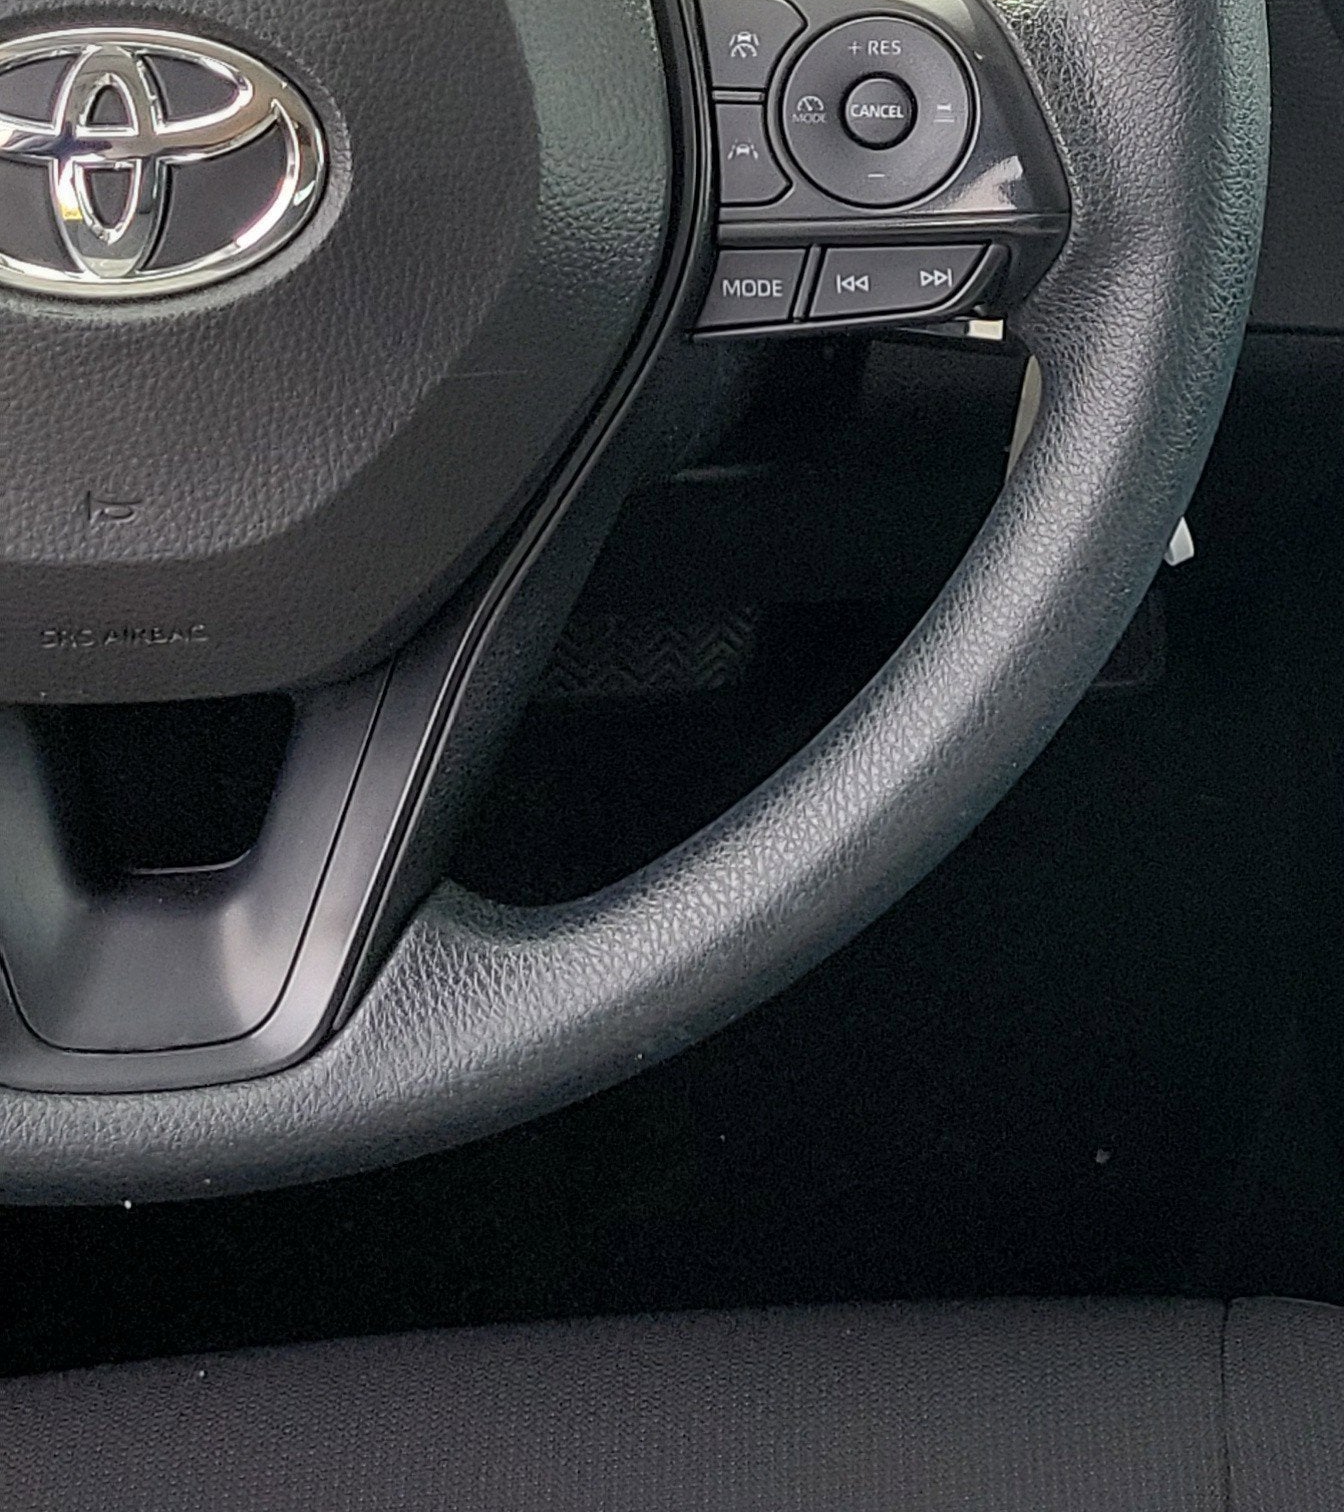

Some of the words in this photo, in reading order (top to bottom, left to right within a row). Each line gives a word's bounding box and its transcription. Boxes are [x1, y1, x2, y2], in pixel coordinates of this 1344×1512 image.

[867, 39, 902, 56] RES
[850, 103, 905, 119] CANCEL
[721, 277, 784, 299] MODE
